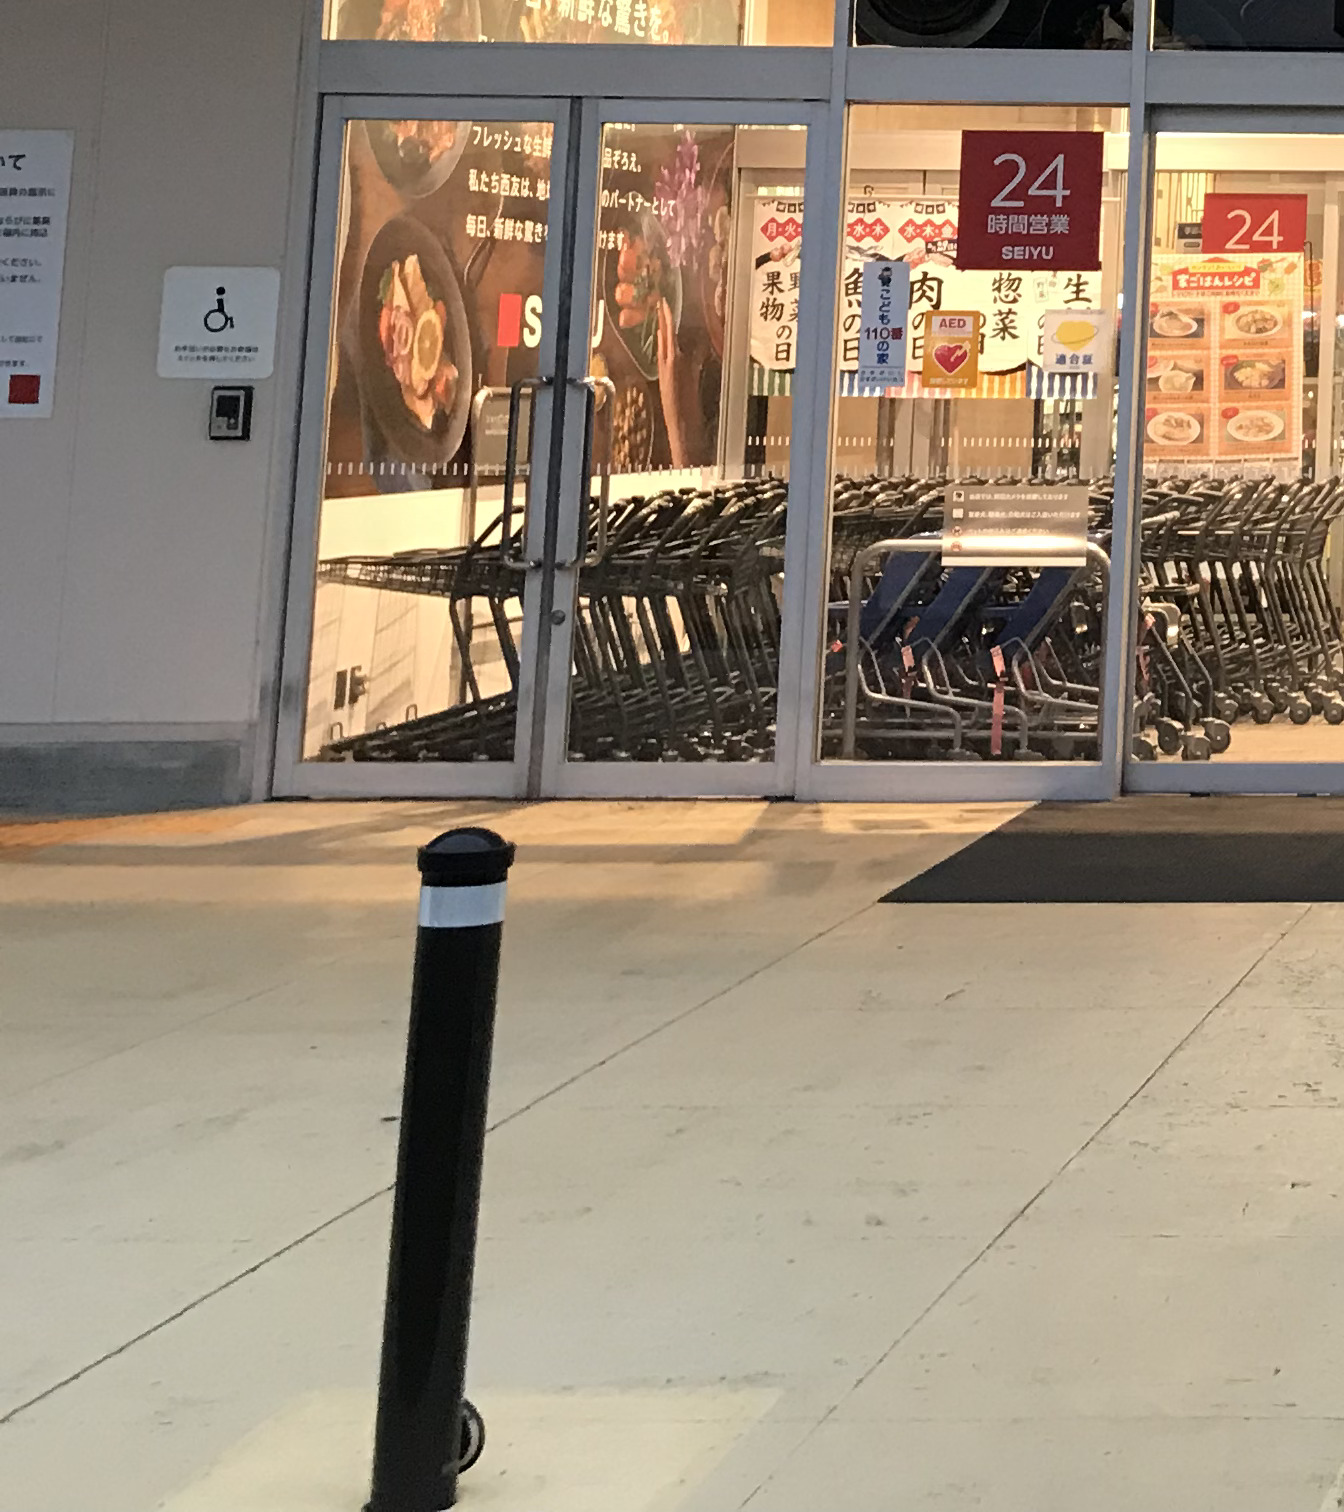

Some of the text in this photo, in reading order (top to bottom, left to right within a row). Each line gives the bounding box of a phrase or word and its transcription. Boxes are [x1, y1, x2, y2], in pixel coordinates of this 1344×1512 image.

[468, 168, 551, 202] 私たち西友は、地
[990, 152, 1071, 208] 24
[987, 213, 1070, 235] 時間営業
[1224, 208, 1284, 250] 24
[1001, 245, 1054, 260] SEIYU
[759, 270, 785, 322] 果物
[988, 271, 1023, 342] 惣菜
[938, 318, 967, 329] AED
[1055, 353, 1094, 366] 適合証
